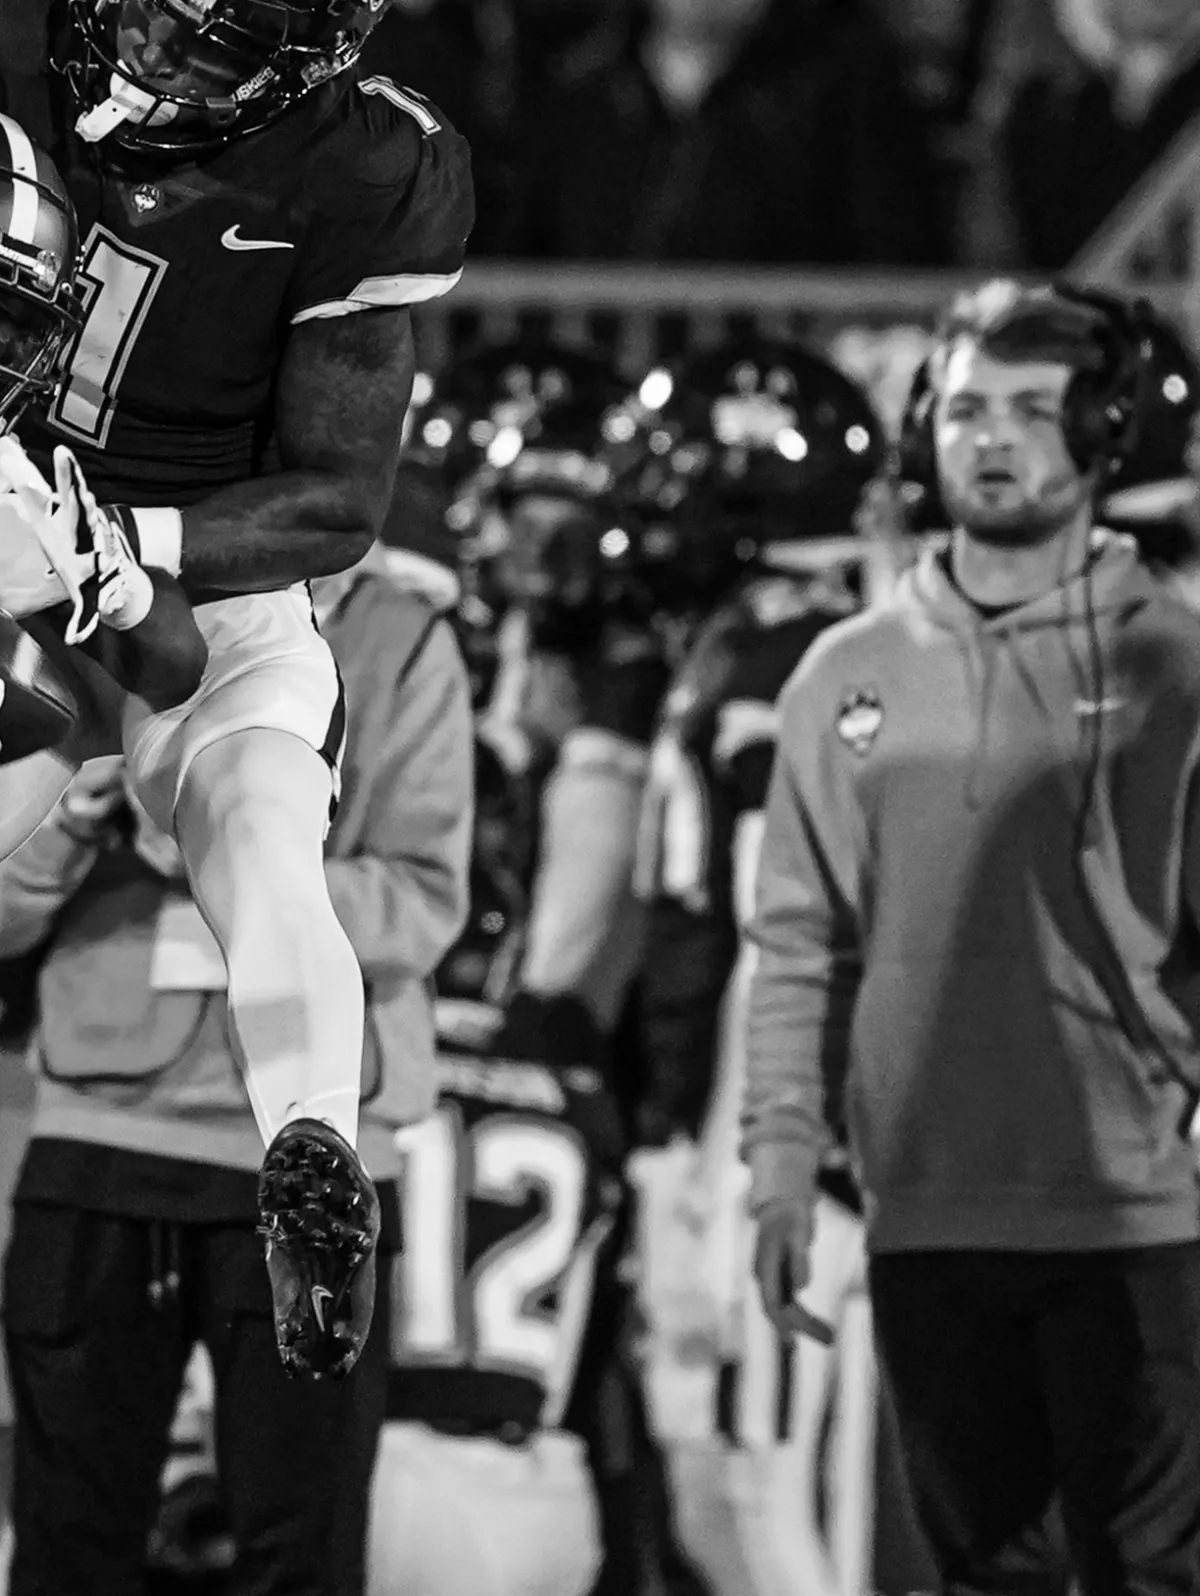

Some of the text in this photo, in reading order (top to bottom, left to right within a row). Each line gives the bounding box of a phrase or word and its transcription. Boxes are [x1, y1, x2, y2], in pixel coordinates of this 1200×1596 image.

[357, 75, 442, 135] 1
[48, 222, 169, 449] 1
[390, 1110, 587, 1374] 12
